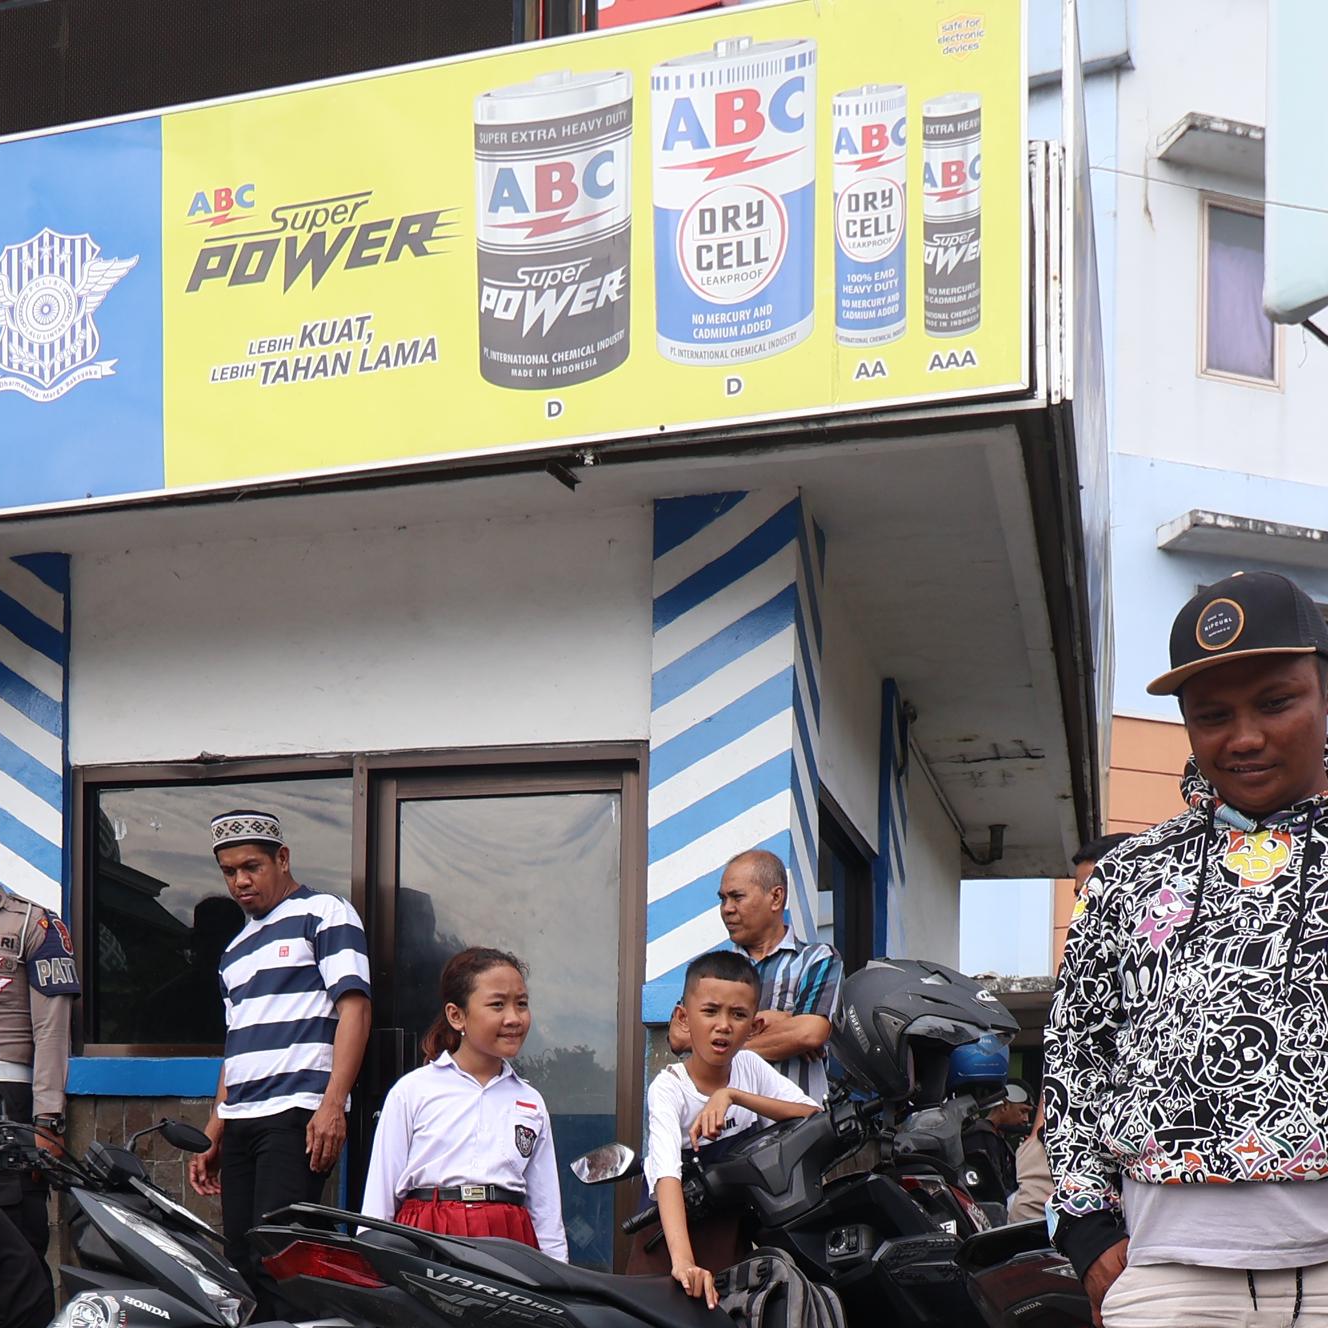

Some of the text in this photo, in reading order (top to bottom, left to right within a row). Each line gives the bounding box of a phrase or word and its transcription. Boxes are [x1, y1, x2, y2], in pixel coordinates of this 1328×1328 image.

[662, 76, 805, 151] ABC
[479, 109, 627, 144] SUPER EXTRA HEAVY DUTY
[834, 117, 906, 155] ABC
[925, 124, 954, 135] EXTRA
[488, 150, 614, 214] ABC
[187, 183, 255, 216] ABC
[848, 188, 893, 213] DRY
[270, 190, 373, 236] Super
[699, 199, 764, 236] DRY
[846, 214, 896, 238] CELL
[932, 228, 976, 247] Super
[185, 206, 459, 296] POWER
[696, 237, 769, 271] CELL
[849, 236, 892, 249] LEAKPROOF
[516, 257, 592, 289] Super
[701, 269, 763, 286] LEAKPROOF
[847, 268, 895, 283] 100% EMD
[843, 278, 899, 294] HEAVY DUTY
[480, 264, 628, 338] POWER
[852, 296, 886, 307] MERCURY
[692, 304, 772, 325] NO MERCURY AND
[249, 315, 374, 355] LEBIH KUAT,
[693, 319, 771, 339] CADMIUM ADDED
[490, 329, 625, 365] INTERNATIONAL CHEMICAL INDUSTRY
[677, 348, 729, 360] INTERNATIONAL
[730, 342, 767, 358] CHEMICAL
[768, 331, 797, 349] INDUSTRY
[211, 337, 437, 385] LEBIH TAHAN LAMA
[511, 358, 598, 377] MADE IN INDONESIA
[855, 361, 886, 379] AA
[928, 350, 976, 371] AAA
[727, 378, 742, 395] D
[547, 401, 562, 418] D
[35, 957, 80, 987] PAT
[426, 1268, 565, 1315] VARIO 160
[122, 1295, 171, 1320] HONDA
[1013, 1301, 1042, 1316] HONDA
